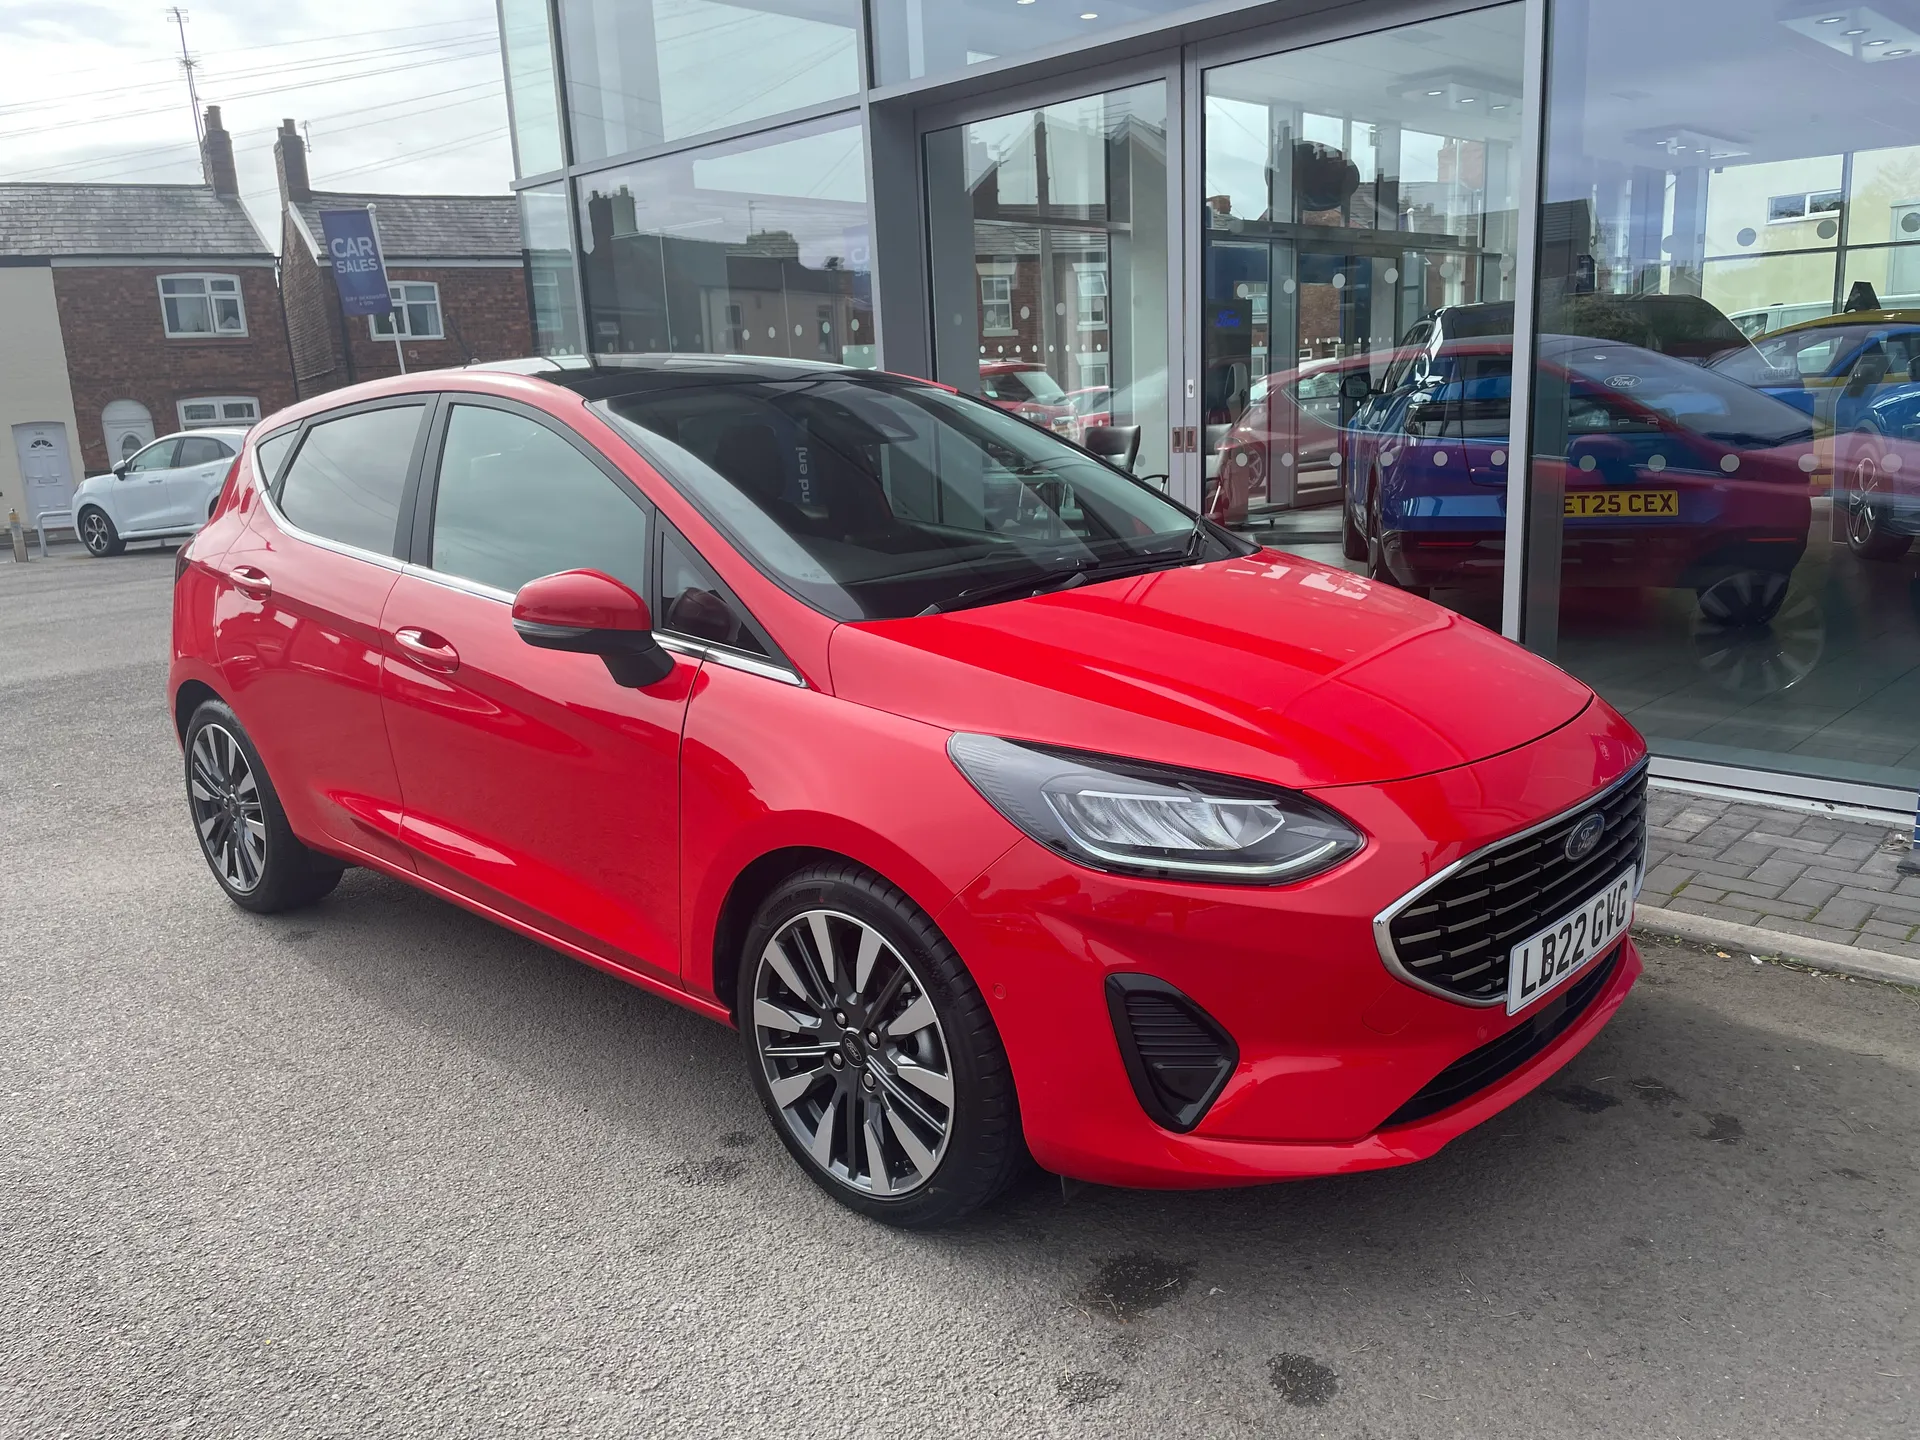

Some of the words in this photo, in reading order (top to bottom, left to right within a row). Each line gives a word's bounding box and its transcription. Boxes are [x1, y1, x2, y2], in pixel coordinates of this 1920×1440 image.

[331, 237, 375, 258] CAR
[336, 258, 379, 274] SALES
[1611, 376, 1636, 386] Ford
[1563, 495, 1621, 514] ET25
[1628, 493, 1673, 513] CEX
[1520, 912, 1587, 1000] LB22
[1591, 879, 1628, 948] GVG
